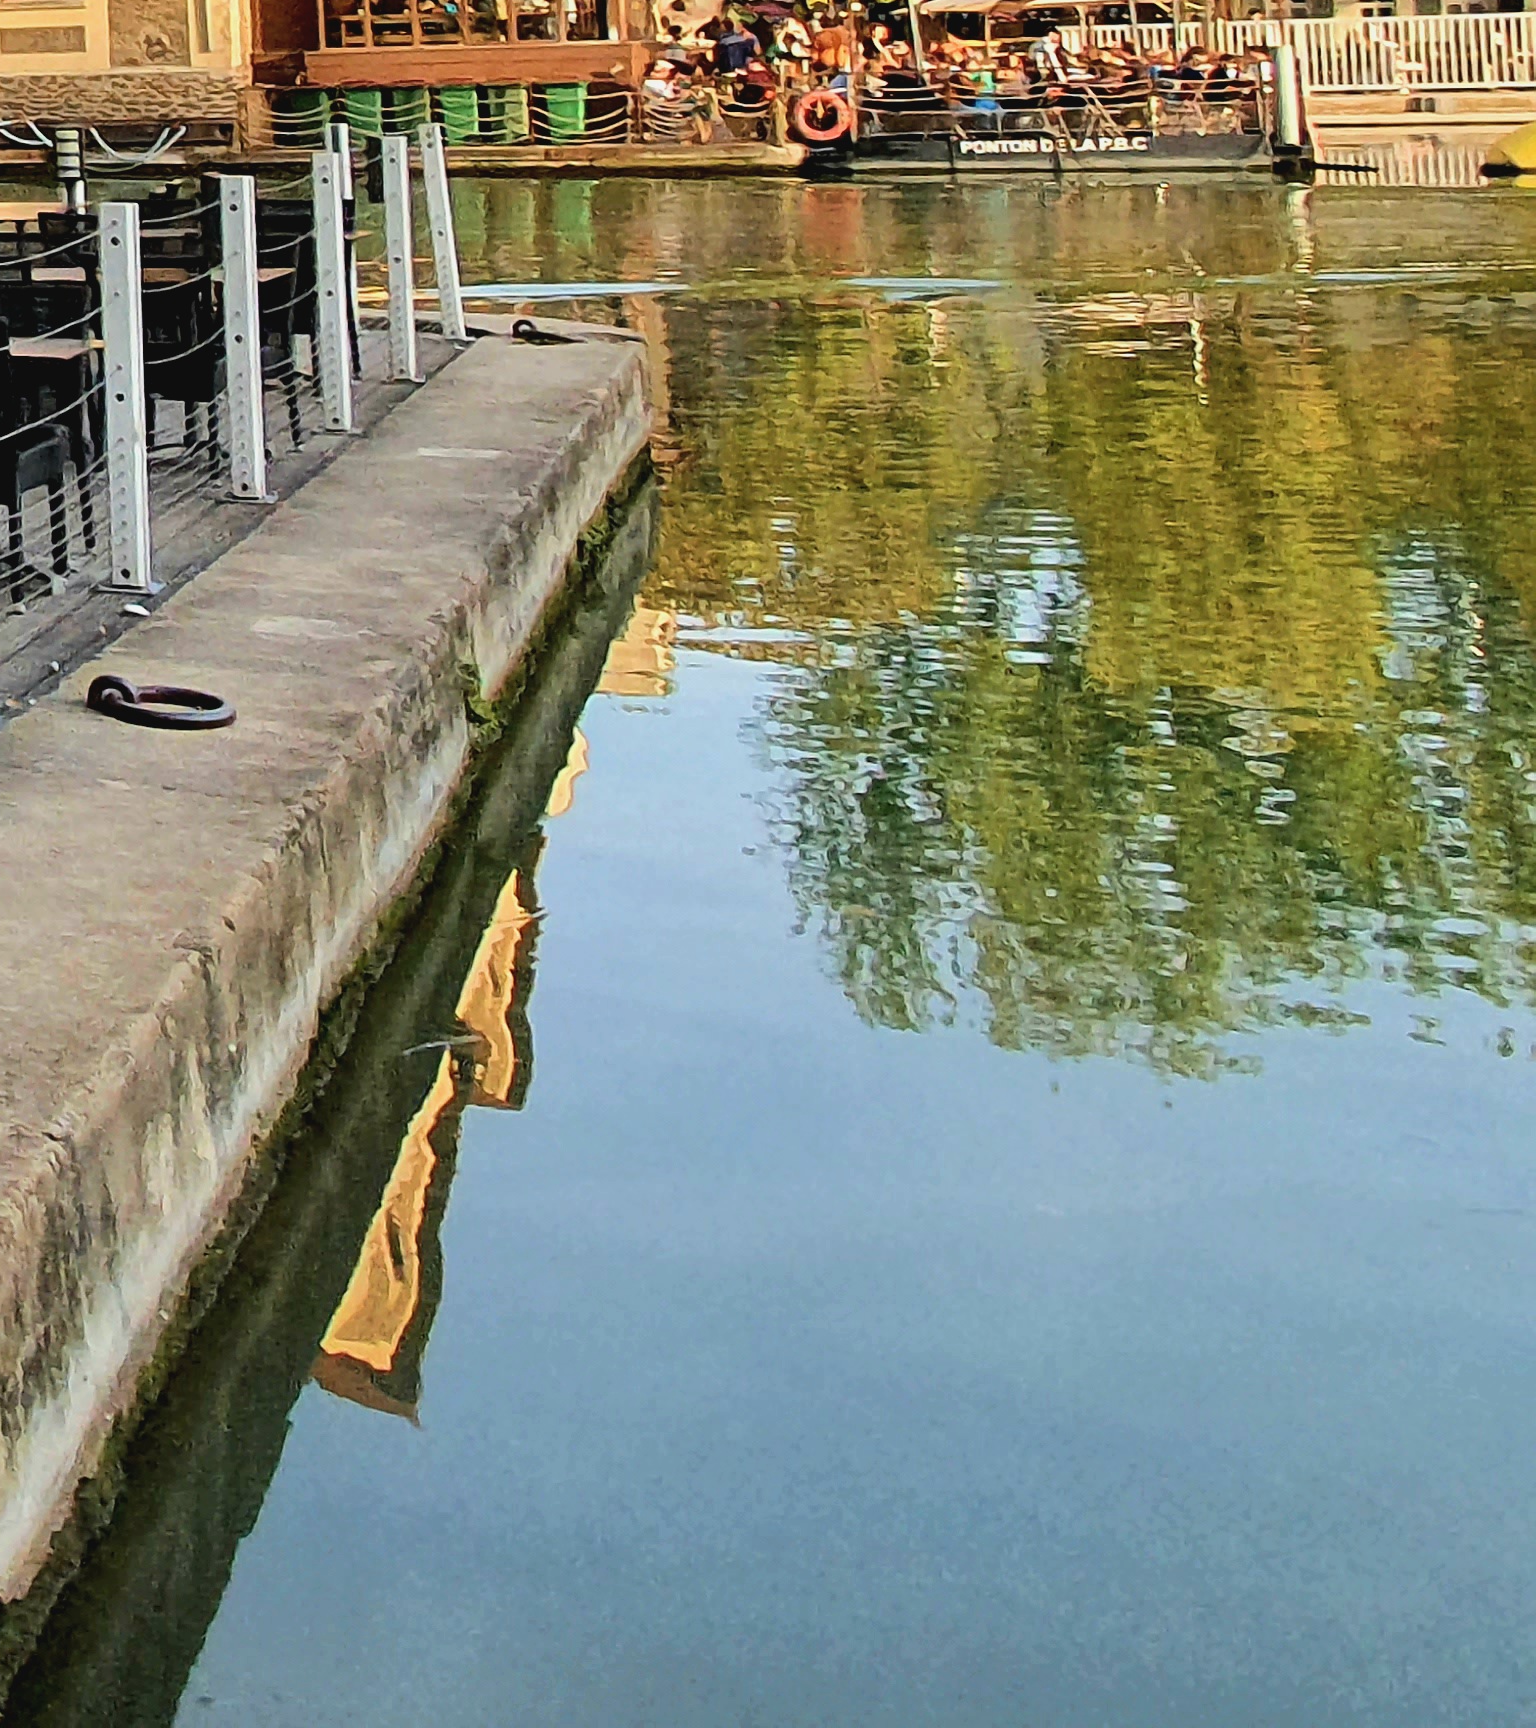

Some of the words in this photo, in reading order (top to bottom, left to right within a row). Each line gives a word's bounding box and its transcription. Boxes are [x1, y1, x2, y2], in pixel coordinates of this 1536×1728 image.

[959, 139, 1038, 154] PONTON
[1039, 137, 1068, 153] DE
[1069, 138, 1097, 152] LA
